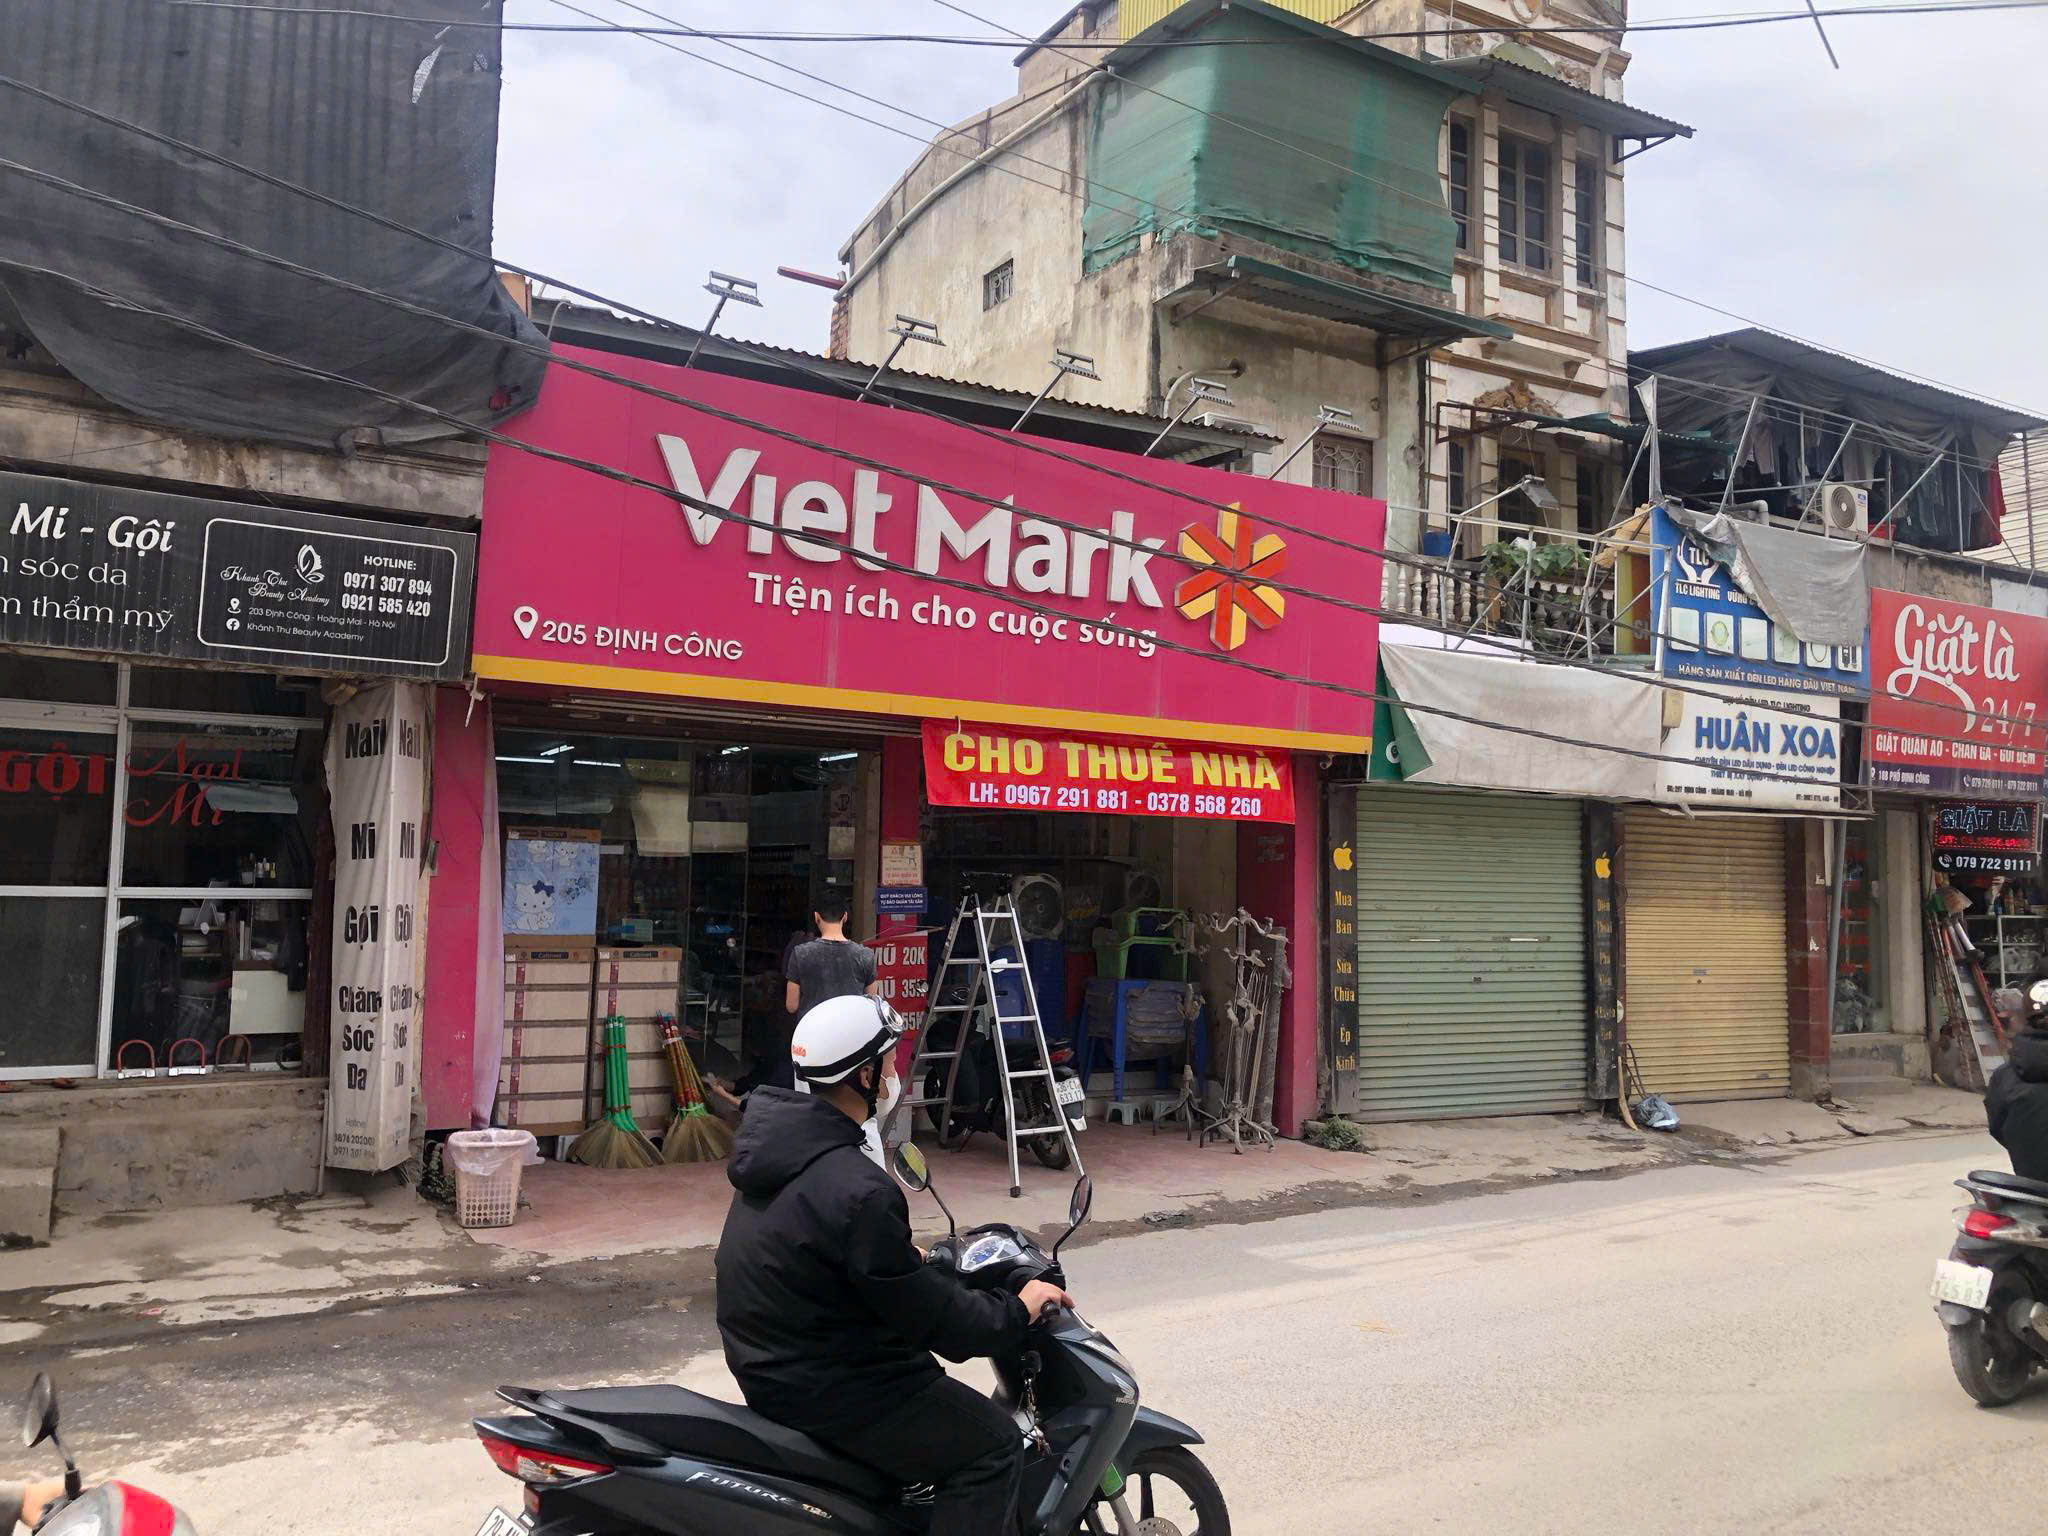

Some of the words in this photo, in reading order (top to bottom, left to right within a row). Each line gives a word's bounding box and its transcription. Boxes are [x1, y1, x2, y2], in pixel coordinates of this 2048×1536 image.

[9, 502, 69, 539] Mi
[107, 516, 176, 557] Gội
[656, 434, 892, 571] Viet
[914, 484, 1166, 608] Mark
[19, 557, 79, 580] sóc
[88, 562, 127, 585] da
[363, 555, 417, 570] HOTLINE:
[248, 582, 284, 601] Beauty
[287, 587, 330, 606] Academy
[344, 571, 375, 590] 0971
[380, 576, 405, 593] 307
[408, 579, 432, 596] 894
[1675, 583, 1689, 595] TLC
[1690, 584, 1721, 600] LIGHTING
[32, 596, 113, 624] thẩm
[124, 610, 174, 632] mỹ
[249, 607, 264, 616] 203
[265, 609, 285, 619] Định
[286, 611, 311, 622] Công
[346, 617, 362, 625] Mai
[341, 593, 373, 611] 0921
[378, 597, 403, 614] 585
[406, 600, 431, 617] 420
[748, 572, 832, 616] Tiện
[844, 584, 899, 620] ích
[911, 595, 977, 629] cho
[988, 606, 1068, 645] cuộc
[1079, 611, 1157, 657] sống
[247, 622, 274, 632] Khánh
[292, 627, 321, 638] Beauty
[323, 630, 364, 642] Academy
[541, 621, 587, 645] 205
[594, 626, 658, 655] ĐỊNH
[664, 631, 744, 661] CÔNG
[1887, 604, 1979, 733] Giặt
[1984, 620, 2021, 682] là
[1981, 697, 2036, 739] 24/7
[345, 719, 387, 759] Nail
[1695, 711, 1771, 753] HUÂN
[1779, 723, 1836, 759] XOA
[1875, 731, 1899, 757] GIẶT
[944, 733, 1043, 776] CHO
[1060, 742, 1177, 784] THUÊ
[1191, 750, 1281, 791] NHÀ
[969, 782, 998, 804] LH:
[1005, 784, 1051, 806] 0967
[1057, 786, 1090, 809] 291
[1097, 789, 1128, 810] 881
[1147, 792, 1189, 814] 0378
[1194, 794, 1226, 815] 568
[1230, 796, 1261, 817] 260
[1940, 806, 1993, 834] GIẶT
[1998, 807, 2029, 831] LÀ
[351, 822, 376, 860] Mi
[400, 822, 415, 859] Mi
[1956, 856, 1977, 868] 079
[1980, 857, 2001, 870] 722
[2004, 859, 2031, 871] 9111
[1335, 890, 1352, 907] Mua
[344, 905, 379, 950] Gội
[1336, 919, 1352, 934] Bán
[903, 946, 925, 966] 20K
[342, 1024, 374, 1052] Sóc
[1340, 1023, 1351, 1046] Ép
[347, 1063, 368, 1091] Da
[685, 1471, 796, 1505] FUTURE
